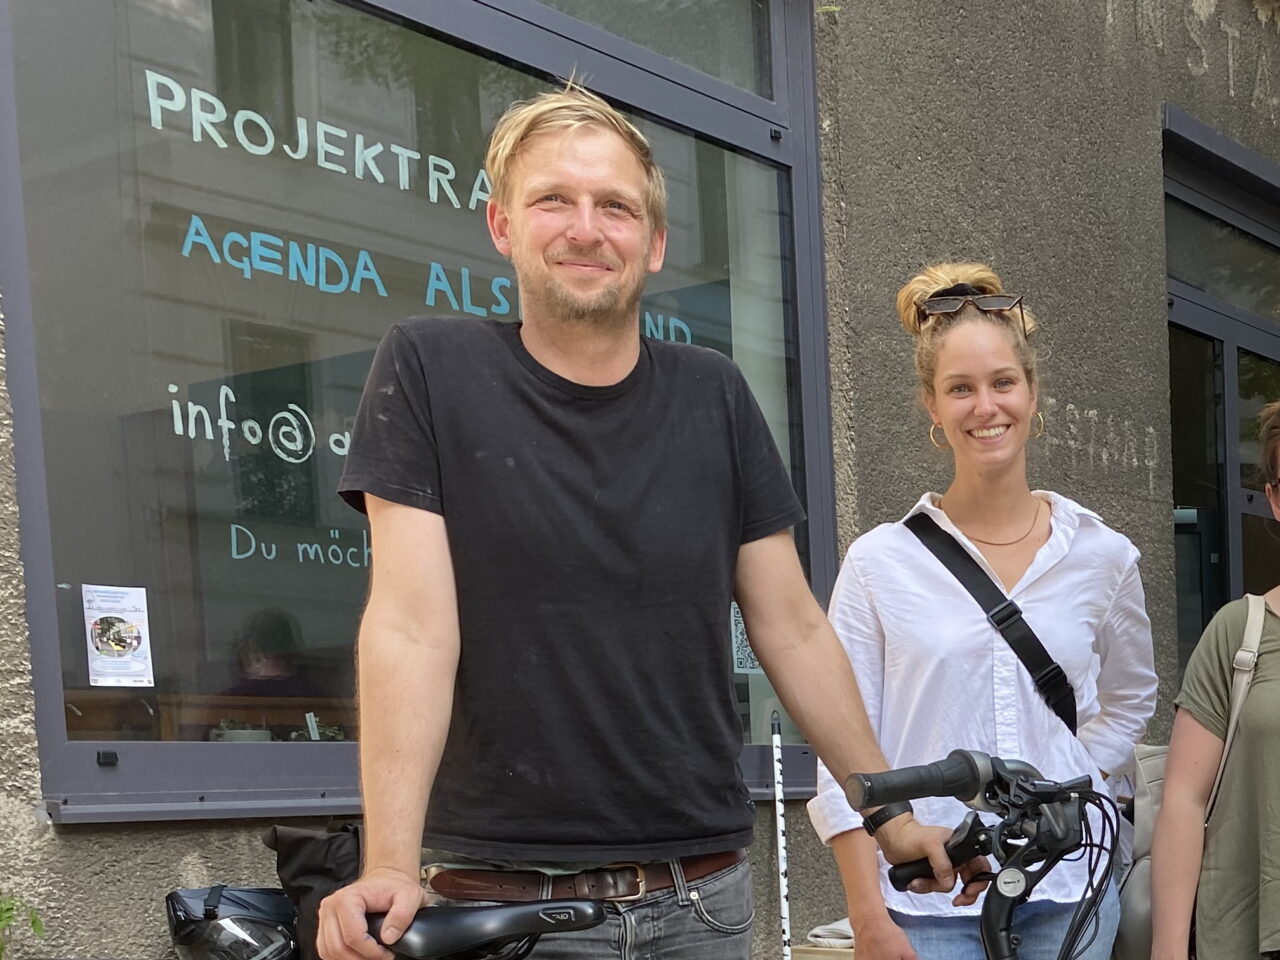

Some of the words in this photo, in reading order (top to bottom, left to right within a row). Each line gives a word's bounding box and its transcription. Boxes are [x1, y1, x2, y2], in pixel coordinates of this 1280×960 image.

[145, 69, 493, 210] PROJEKTRA
[182, 215, 388, 297] AGENDA
[231, 524, 276, 560] Du
[297, 530, 372, 567] möch
